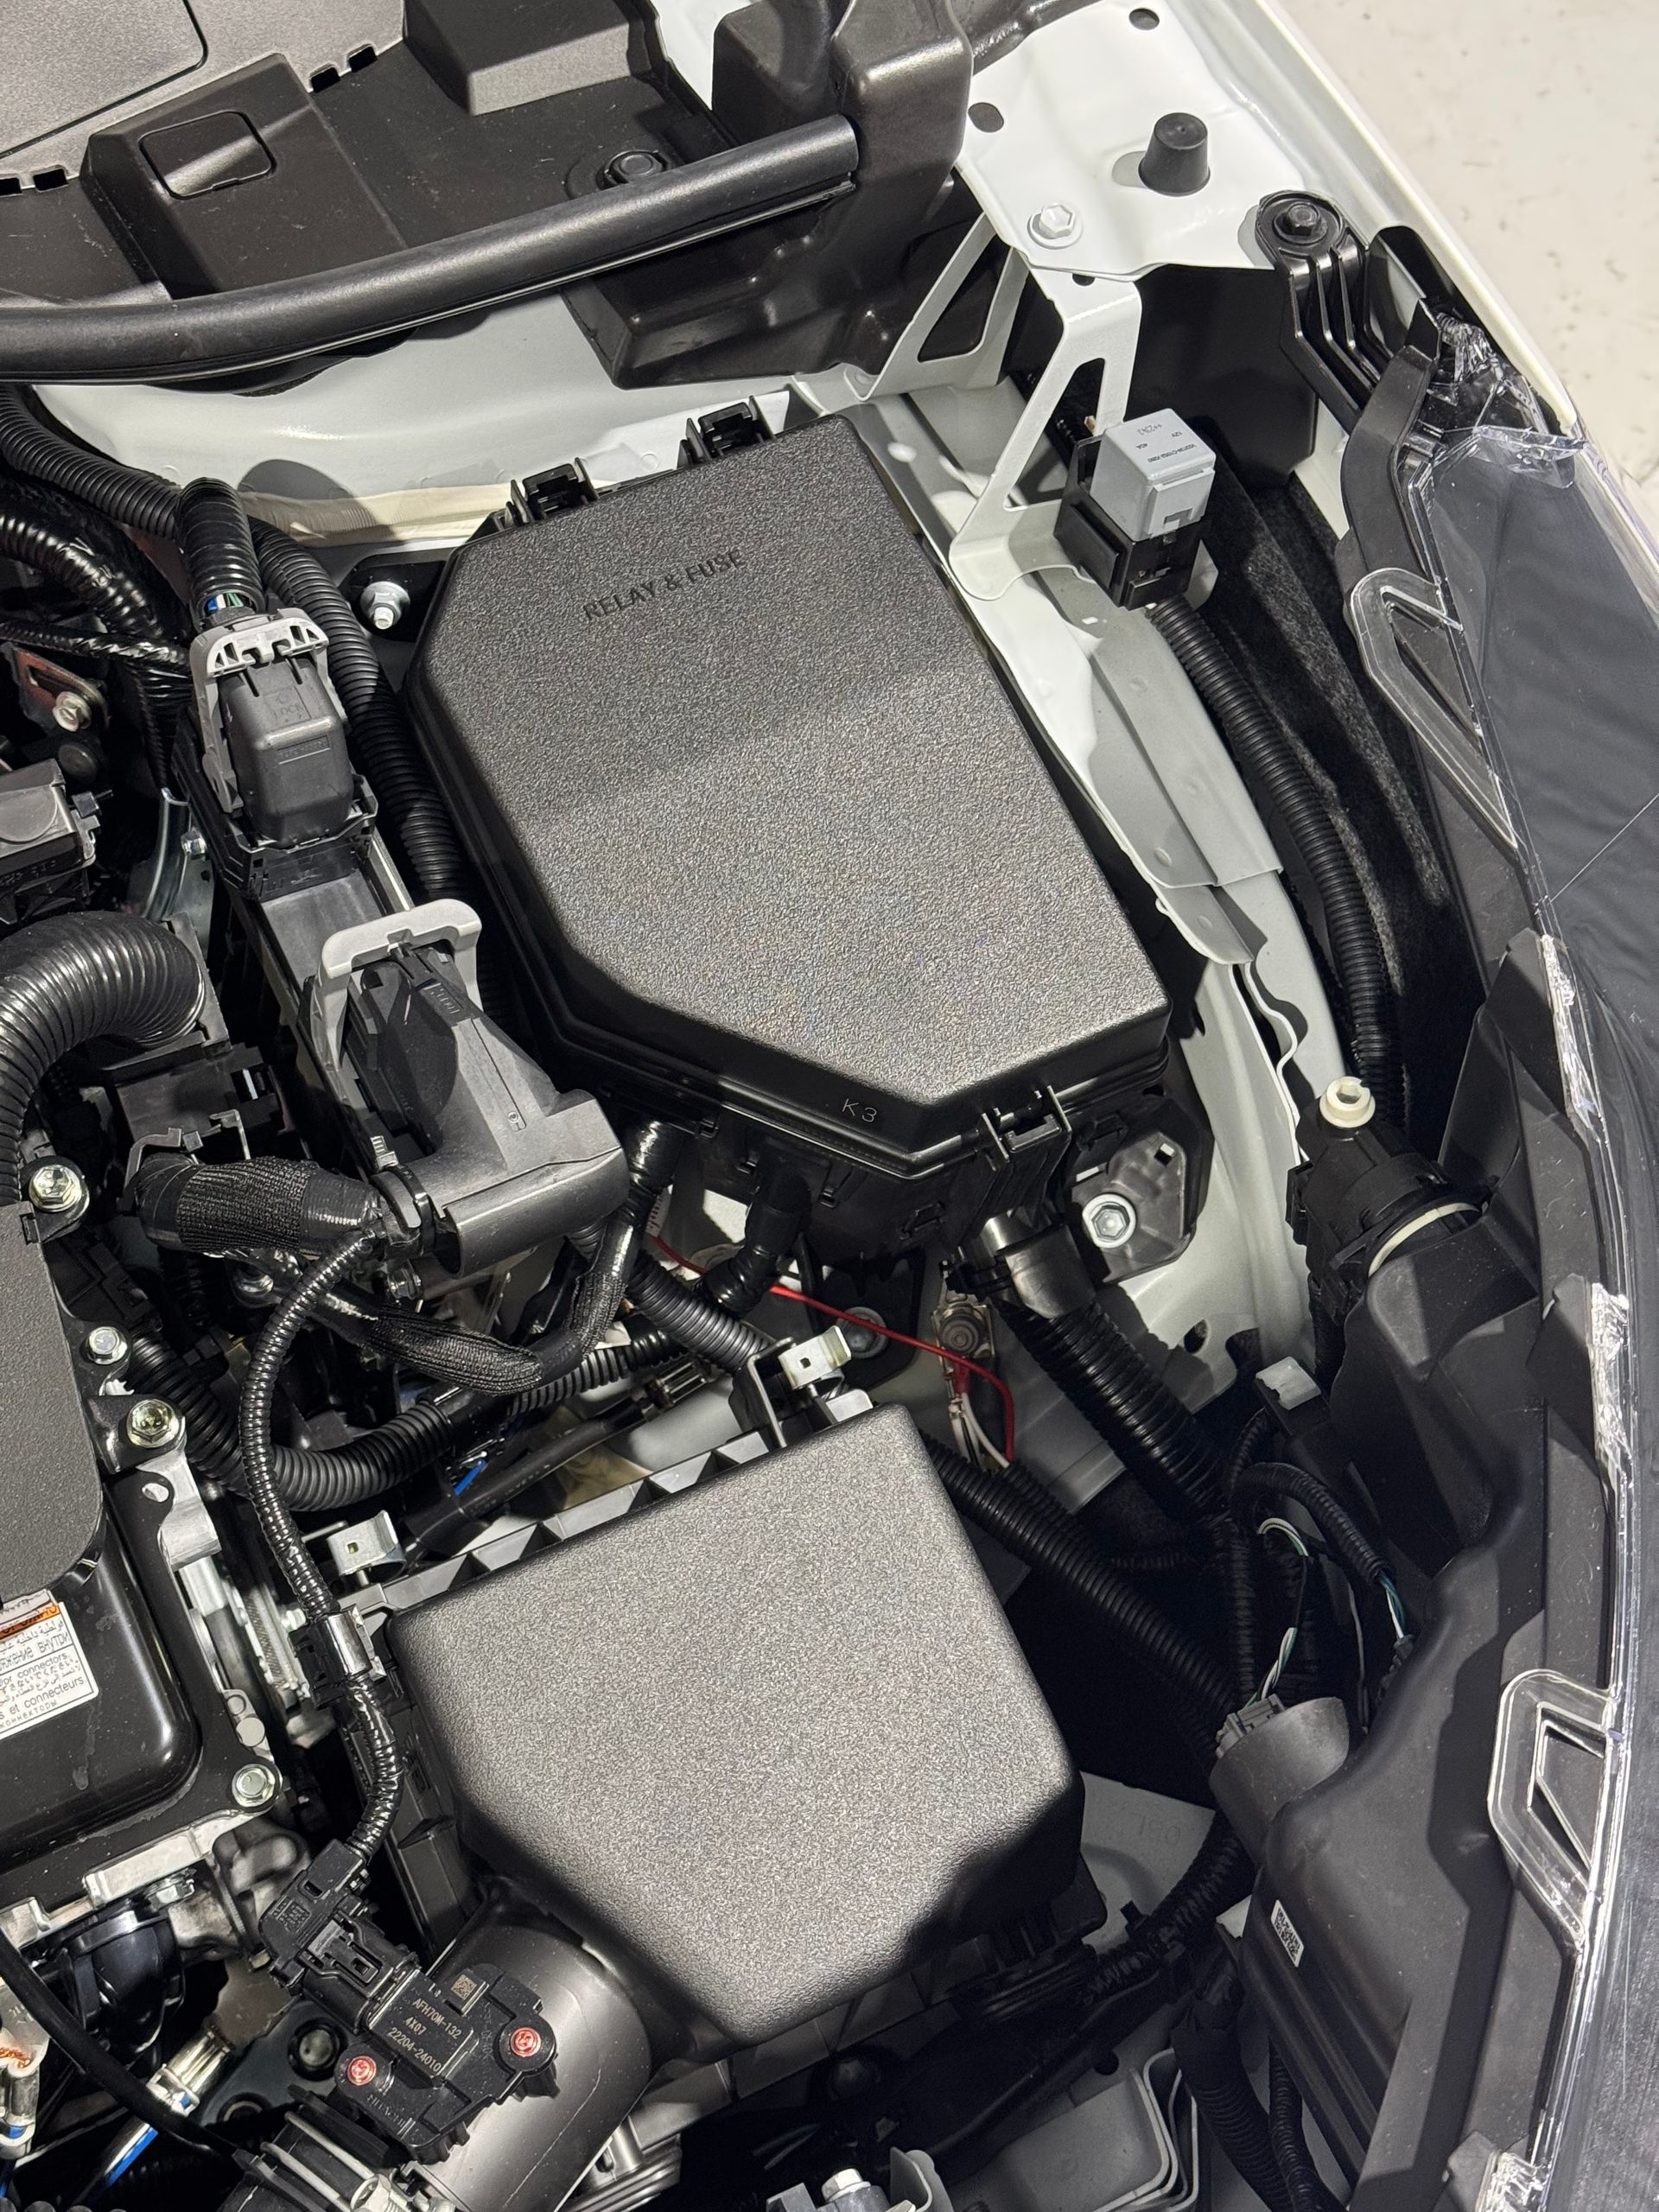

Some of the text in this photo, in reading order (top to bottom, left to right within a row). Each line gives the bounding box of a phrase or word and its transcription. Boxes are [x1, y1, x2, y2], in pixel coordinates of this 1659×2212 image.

[582, 552, 746, 620] RELAY & FUSE
[842, 1098, 878, 1122] K3
[9, 1703, 21, 1716] et
[404, 2017, 427, 2036] 4X07
[412, 1998, 462, 2040] AFH70M-132
[387, 2026, 442, 2073] 22204-24010
